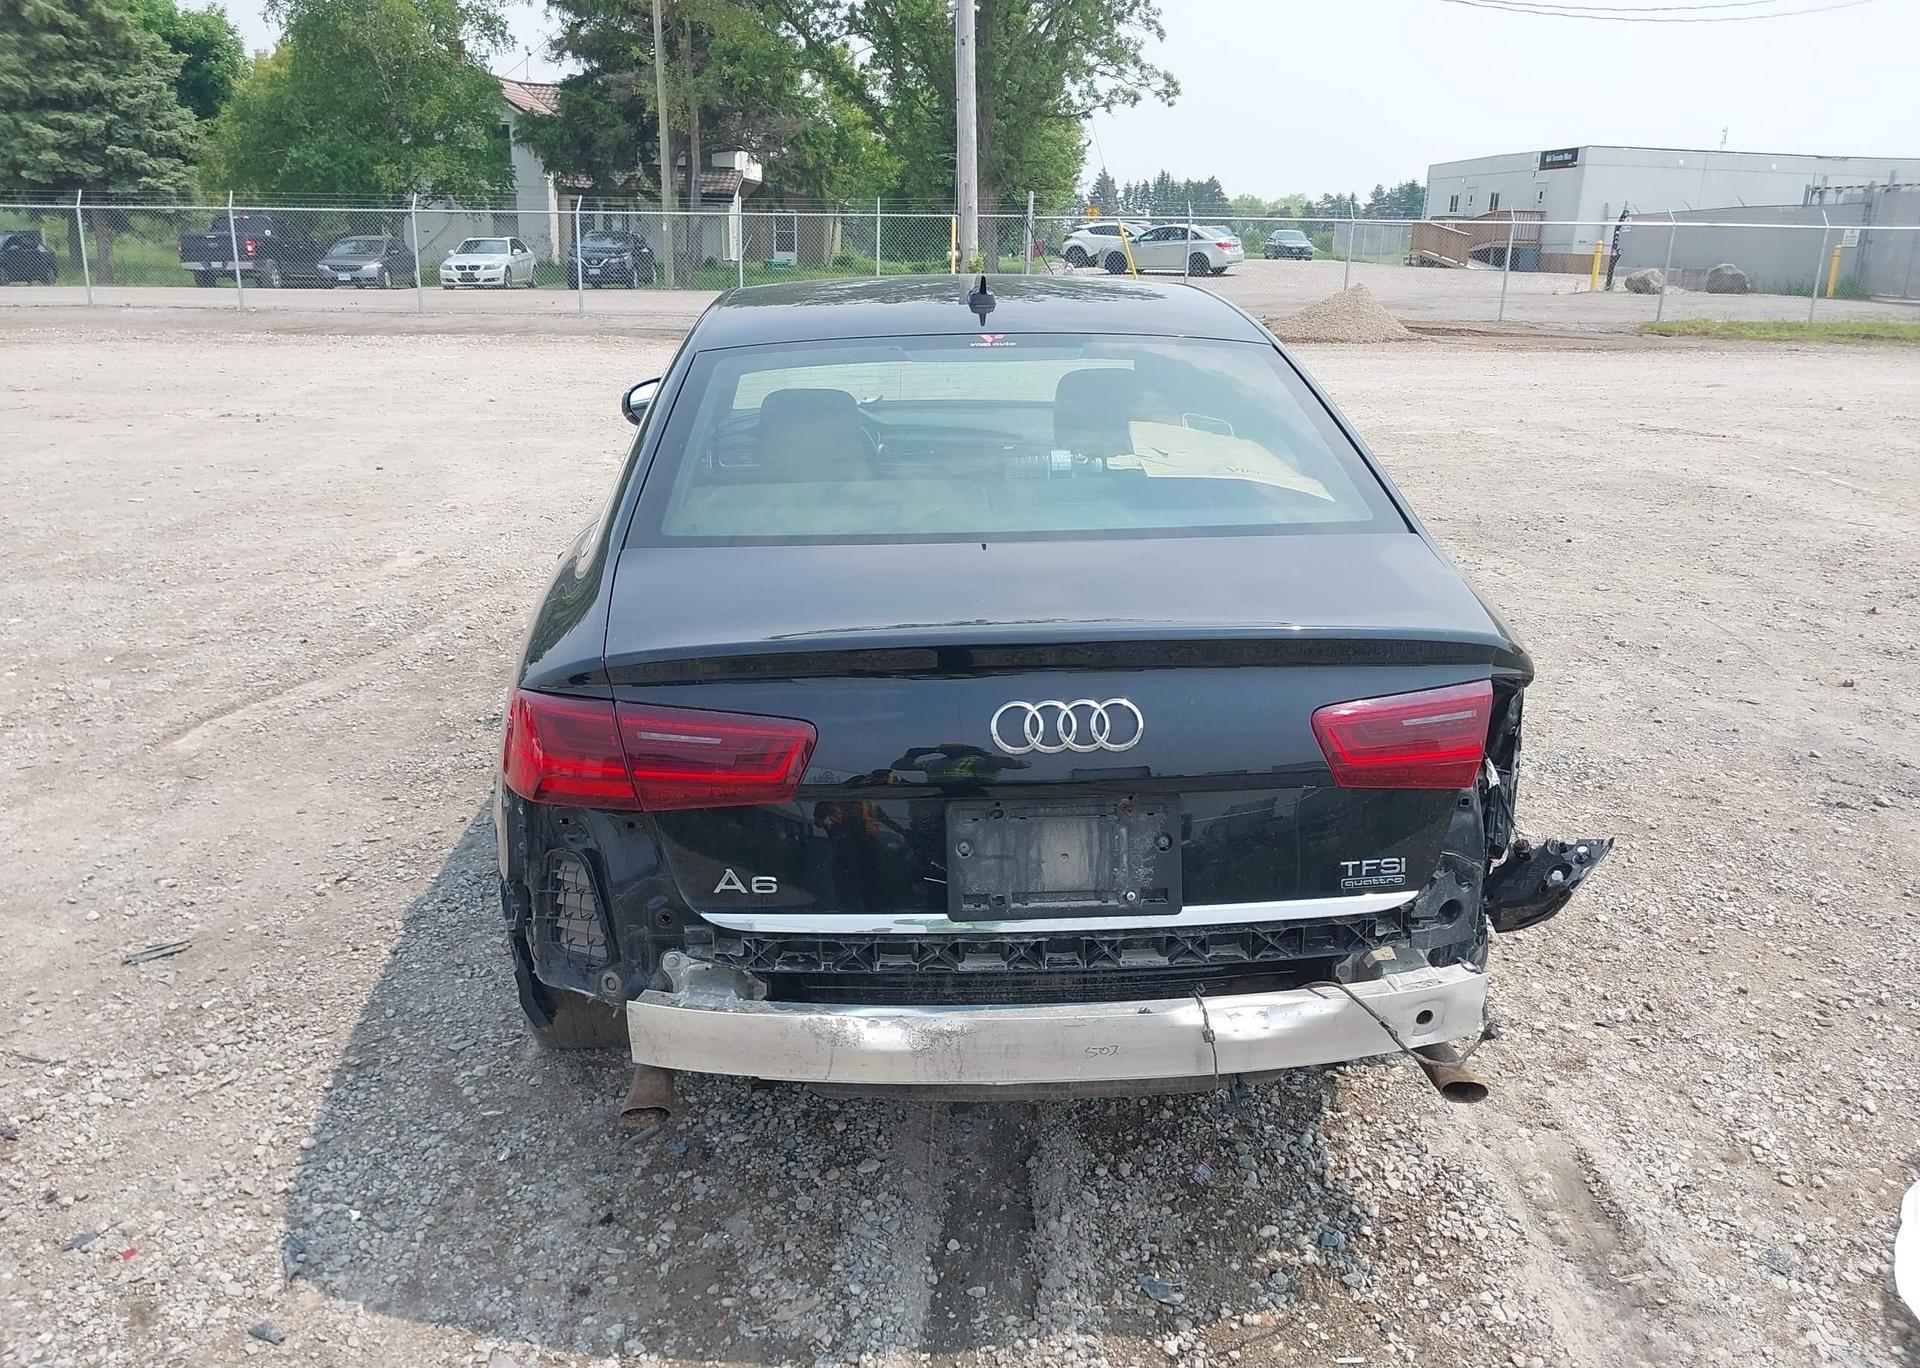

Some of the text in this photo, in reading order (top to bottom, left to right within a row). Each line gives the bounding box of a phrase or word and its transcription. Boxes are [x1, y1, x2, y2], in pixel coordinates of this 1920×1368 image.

[1340, 857, 1406, 876] TFSI
[713, 868, 778, 894] A6
[1344, 877, 1403, 888] quattro
